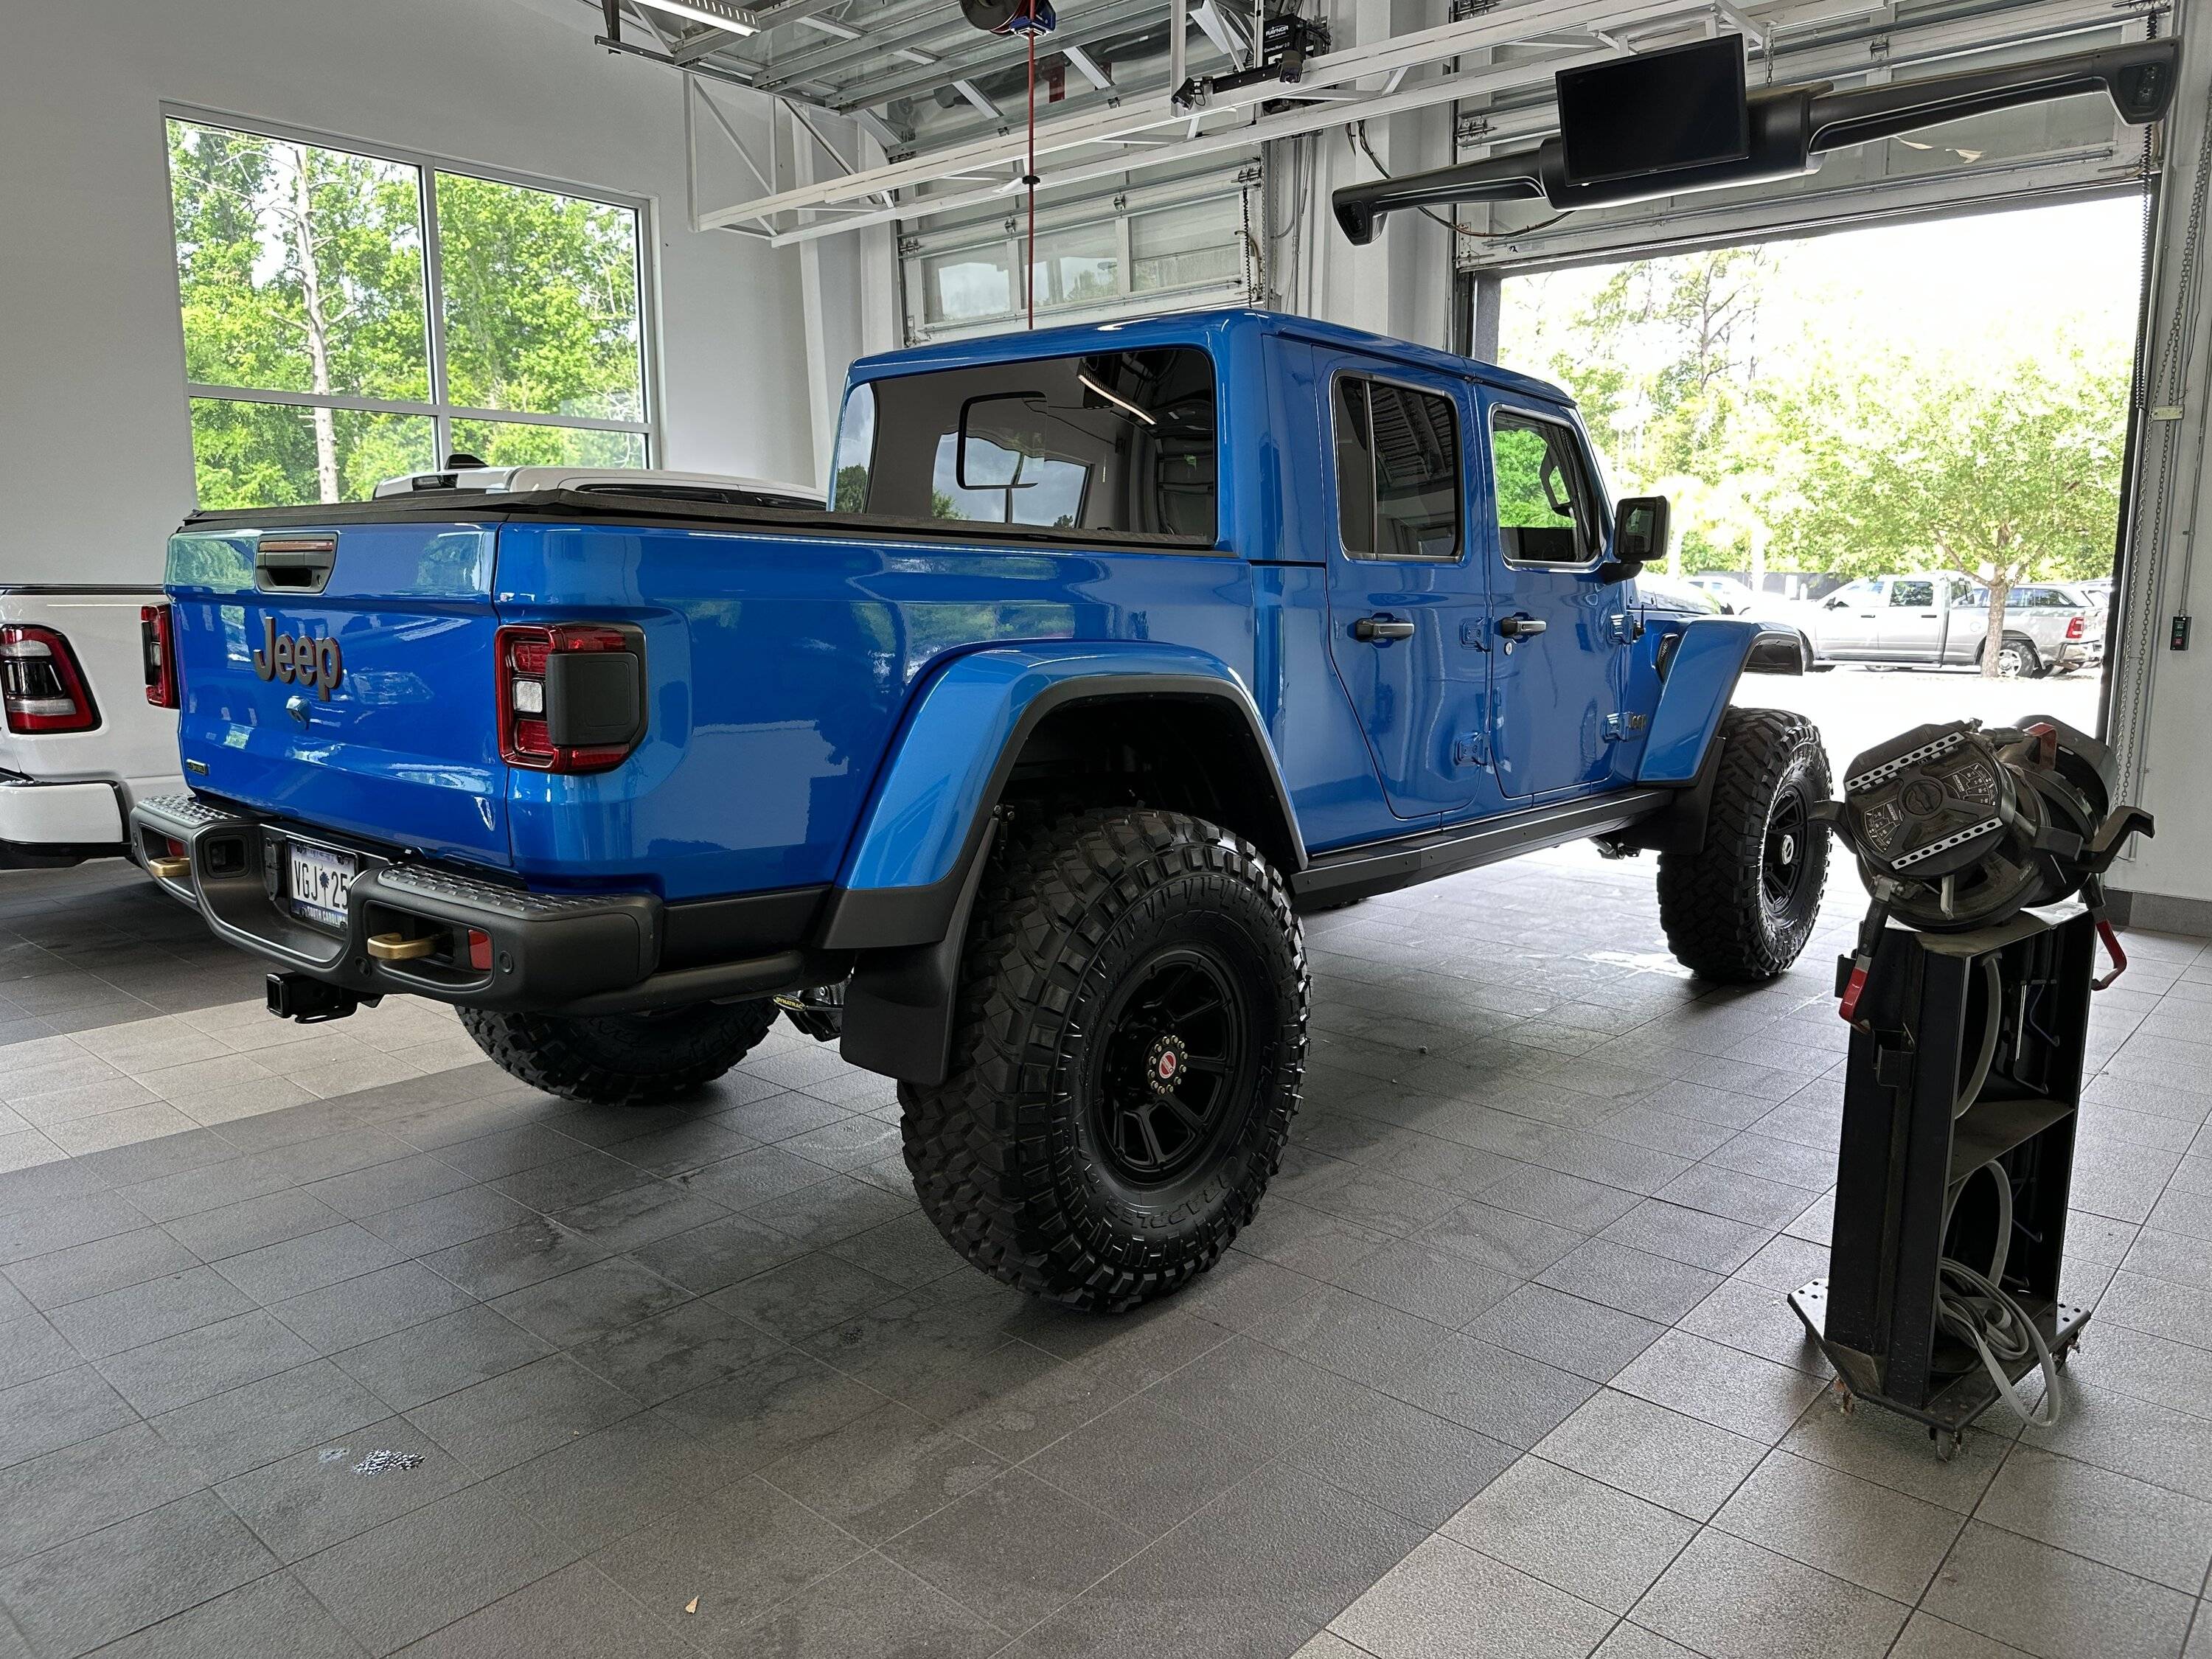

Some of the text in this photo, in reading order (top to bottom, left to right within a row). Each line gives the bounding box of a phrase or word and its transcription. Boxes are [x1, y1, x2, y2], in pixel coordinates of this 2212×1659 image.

[1265, 25, 1289, 36] RAYNOR
[253, 616, 342, 702] Jeep
[294, 860, 354, 910] VGJ 25
